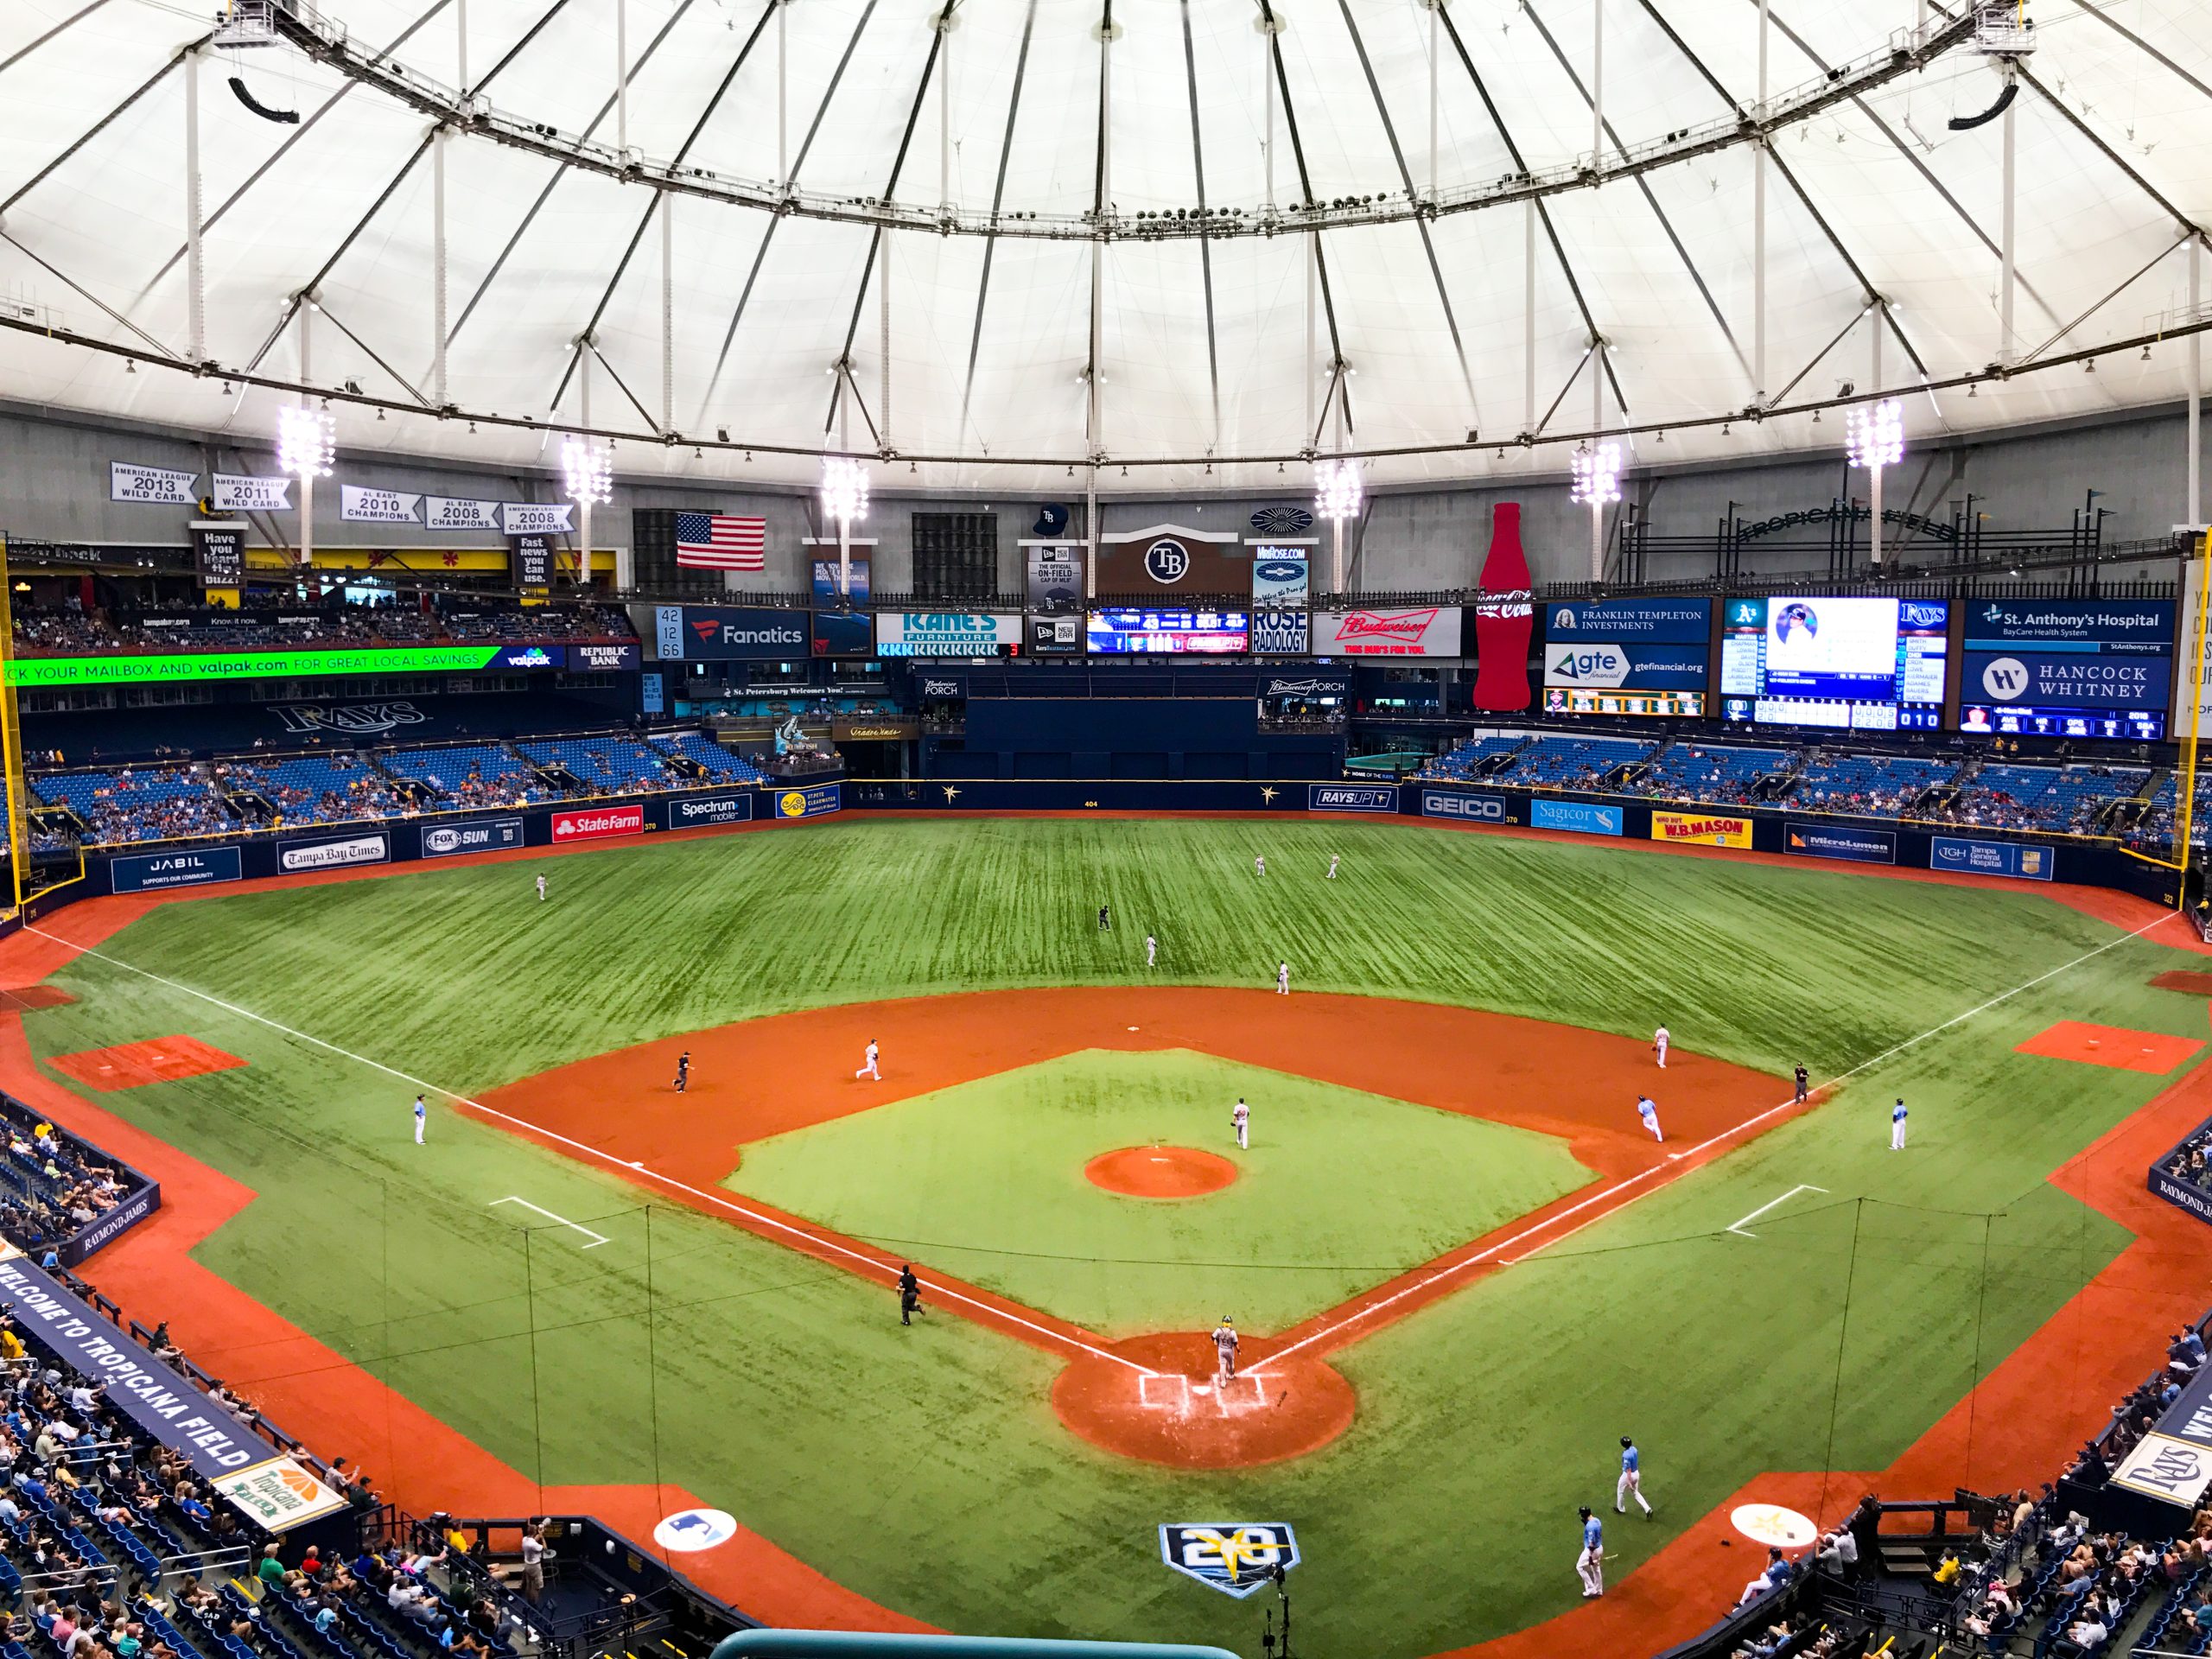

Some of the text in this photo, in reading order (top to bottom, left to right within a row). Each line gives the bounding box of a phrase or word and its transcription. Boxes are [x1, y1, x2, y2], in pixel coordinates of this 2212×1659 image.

[115, 467, 192, 481] AMERICAN LEAGUE
[134, 477, 175, 493] 2013
[216, 478, 254, 486] AMERICAN
[122, 488, 185, 502] WILD CARD
[234, 486, 270, 499] 2011
[222, 498, 280, 508] WILD CARD
[360, 498, 399, 512] 2010
[347, 509, 410, 521] CHAMPIONS
[442, 507, 480, 519] 2008
[519, 513, 555, 524] 2008
[432, 518, 490, 528] CHAMPIONS
[205, 533, 235, 543] Have
[520, 537, 543, 547] Fast
[209, 545, 232, 555] you
[520, 548, 548, 556] news
[524, 556, 543, 567] you
[1153, 548, 1182, 575] TB
[524, 574, 546, 583] use.
[662, 609, 677, 622] 42
[1254, 612, 1306, 630] ROSE
[1582, 611, 1635, 620] FRANKLIN
[1901, 603, 1944, 626] RAYS
[2004, 613, 2158, 629] St. Anthony's Hospital
[1346, 617, 1427, 632] Budweiser
[1582, 621, 1654, 630] INVESTMENTS
[664, 627, 677, 639] 12
[723, 626, 803, 644] Fanatics
[2003, 628, 2033, 637] BayCare
[1254, 632, 1306, 652] RADIOLOGY
[580, 646, 629, 656] REPUBLIC
[663, 644, 678, 656] 66
[1009, 643, 1018, 656] 3
[35, 653, 480, 678] YOUR MAILBOX AND valpak.com FOR GREAT LOCAL SAVINGS
[507, 656, 550, 668] valpak
[591, 656, 620, 665] BANK
[1579, 652, 1617, 674] gte
[1635, 663, 1703, 674] gtefinancial.org
[2039, 665, 2147, 681] HANCOCK
[1312, 683, 1345, 691] PORCH
[2039, 682, 2146, 698] WHITNEY
[266, 702, 424, 733] RAYS
[1901, 714, 1938, 727] 0 1 0
[682, 801, 735, 817] Spectrum
[1426, 796, 1502, 817] GEICO
[1540, 803, 1592, 823] Sagicor
[711, 811, 735, 822] mobile
[435, 834, 454, 843] FOX
[463, 830, 488, 844] SUN
[1810, 836, 1888, 850] MicroLumen
[289, 845, 380, 864] Tampa Bay Times
[1942, 847, 1966, 857] TGH
[1970, 846, 1996, 855] Tampa
[150, 857, 204, 871] JABIL
[1970, 859, 2002, 868] Hospital
[143, 876, 168, 886] SUPPORTS
[181, 872, 213, 881] COMMUNITY
[2164, 893, 2173, 905] 322
[2160, 1179, 2203, 1212] RAYMOND
[85, 1198, 148, 1251] RAYMOND JAMES
[0, 1262, 251, 1467] WELCOME TO TROPICANA FIELD
[2126, 1446, 2201, 1492] RAYS
[251, 1470, 302, 1511] Tropicana
[238, 1490, 274, 1511] FIELD
[1180, 1528, 1281, 1567] 20
